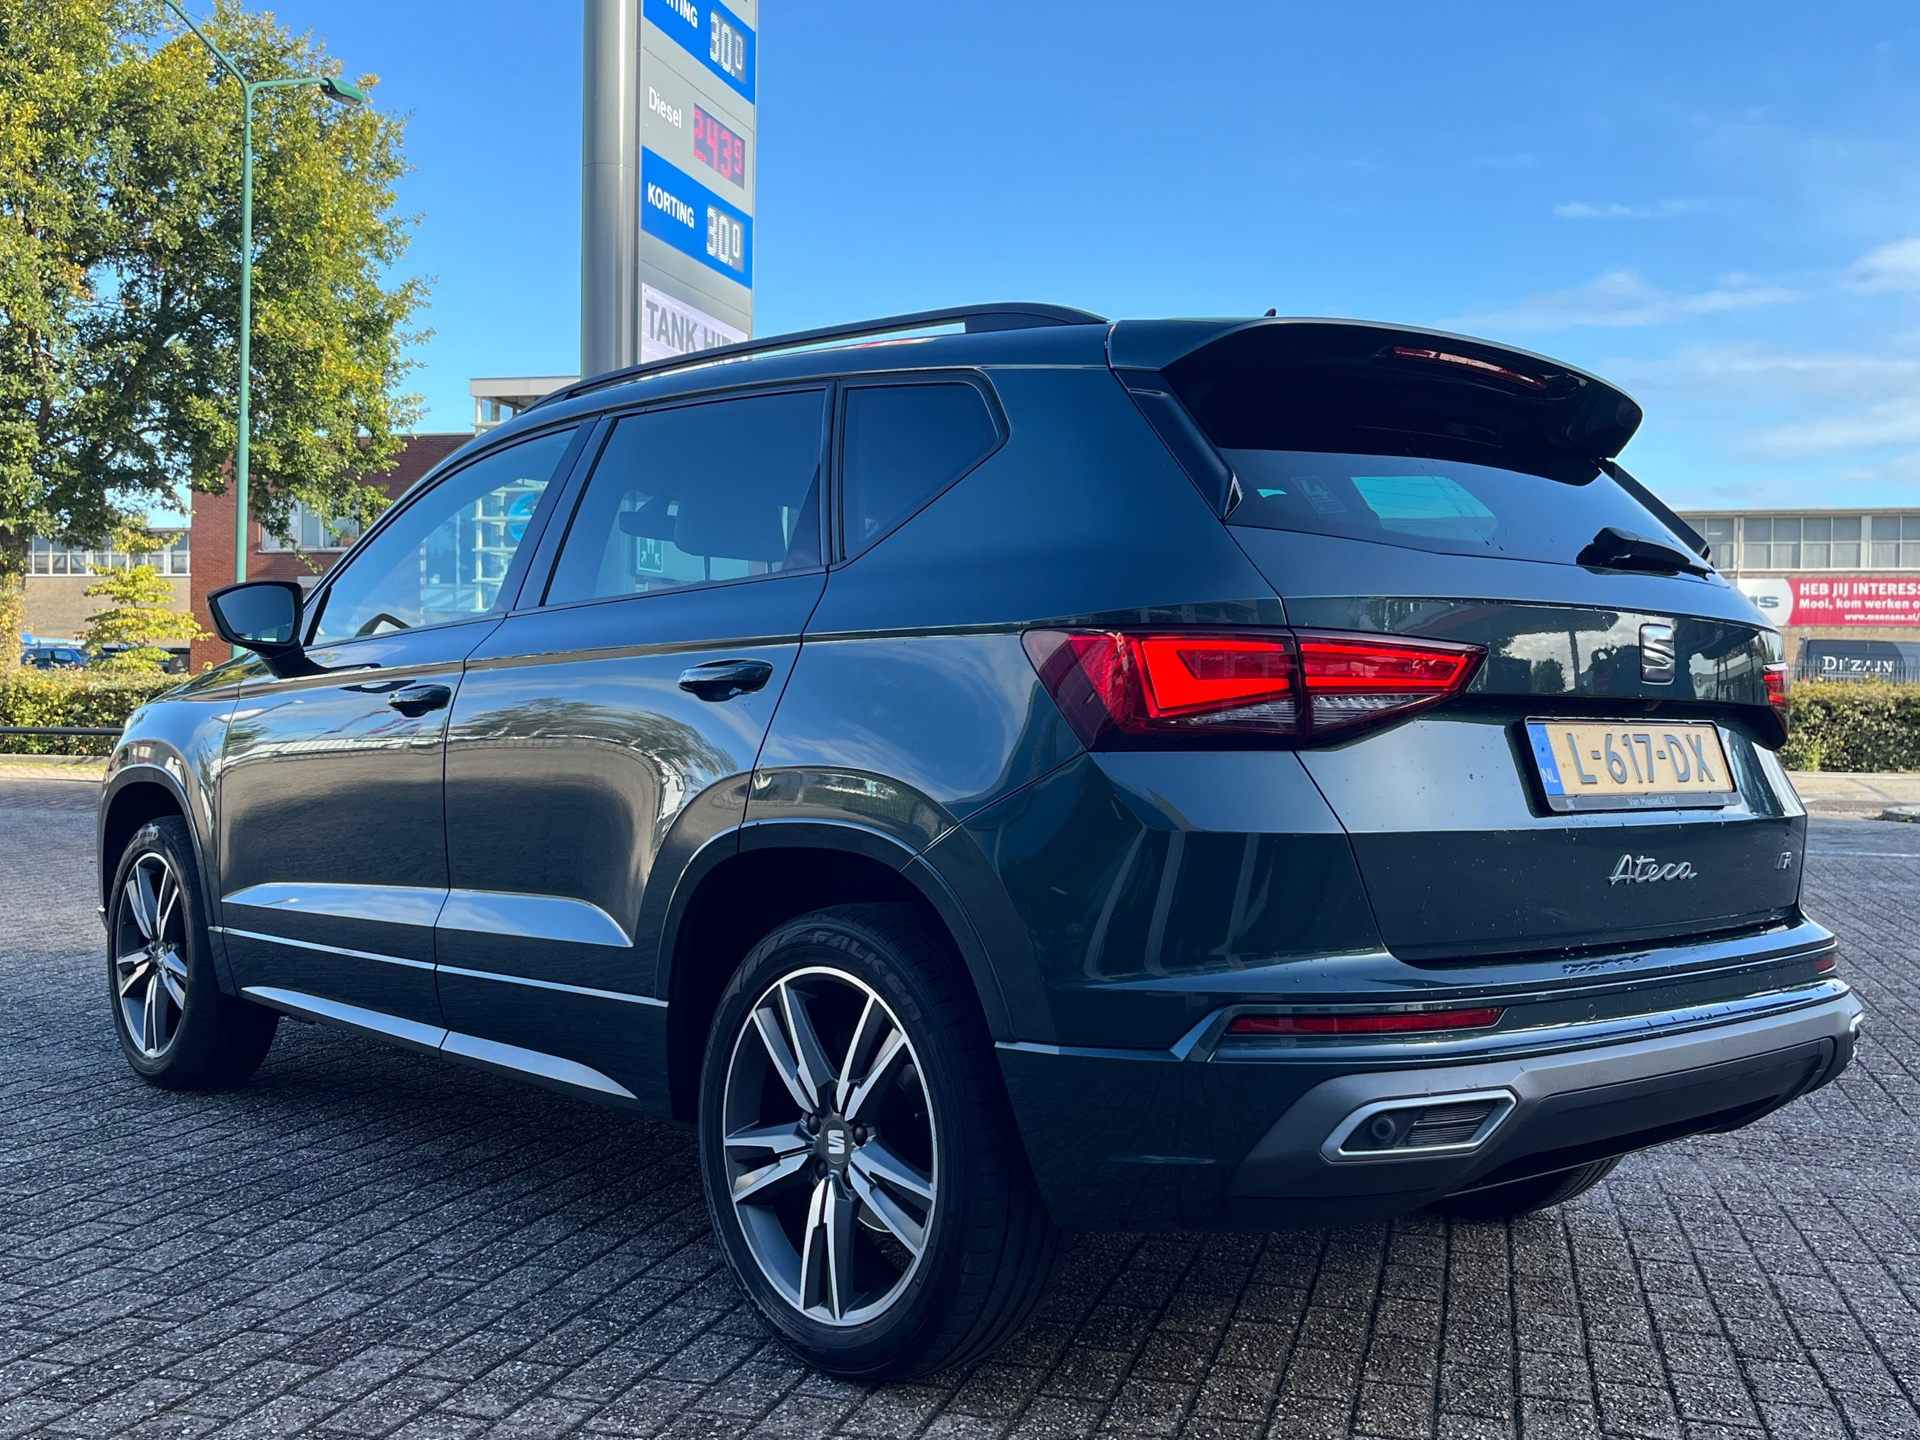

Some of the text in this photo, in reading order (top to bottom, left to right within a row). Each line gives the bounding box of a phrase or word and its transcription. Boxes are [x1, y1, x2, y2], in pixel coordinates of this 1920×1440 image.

[648, 86, 682, 129] Diesel
[647, 181, 695, 229] KORTING
[645, 299, 698, 354] TANK
[1800, 582, 1829, 596] HEB
[1832, 582, 1849, 598] JIJ
[1836, 598, 1861, 609] kom
[1864, 598, 1910, 609] werken
[1541, 767, 1559, 783] NL
[1567, 733, 1716, 785] L-617-DX
[1608, 854, 1698, 886] Ateca
